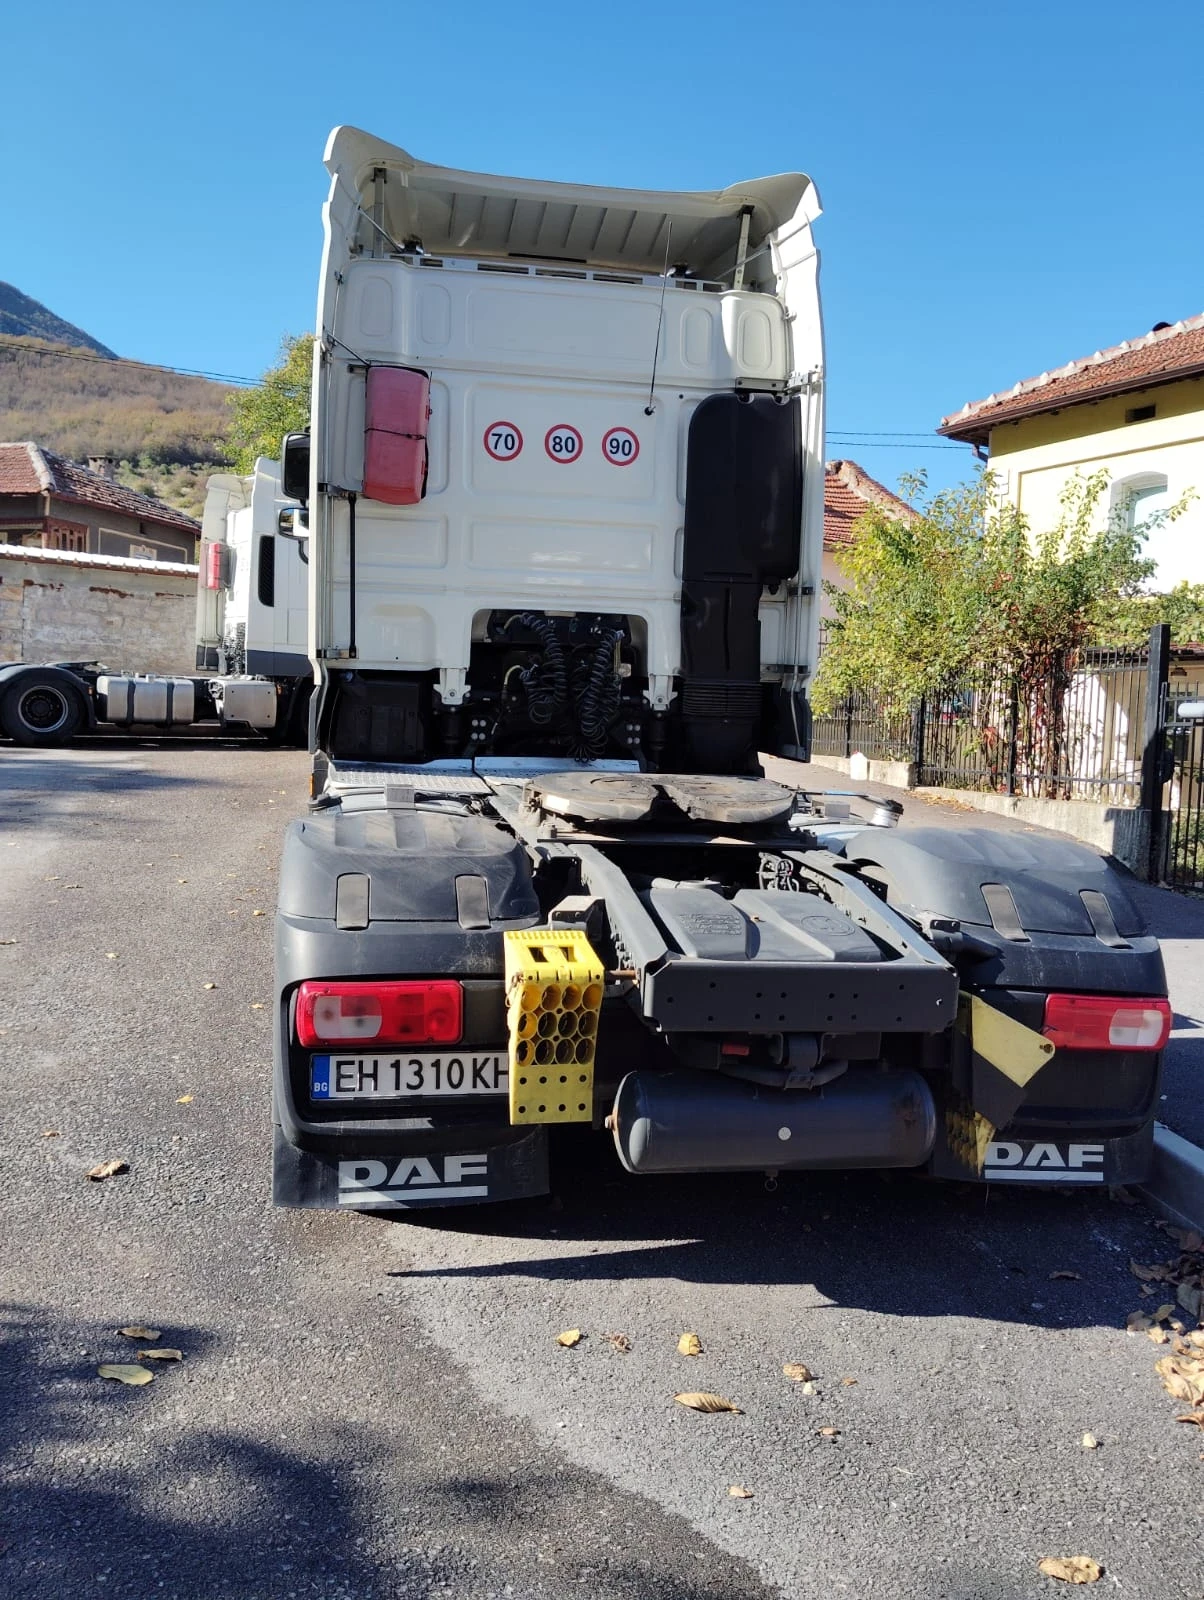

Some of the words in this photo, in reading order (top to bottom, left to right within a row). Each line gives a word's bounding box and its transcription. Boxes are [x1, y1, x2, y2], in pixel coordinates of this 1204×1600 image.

[491, 433, 515, 450] 70
[552, 436, 576, 453] 80
[609, 438, 632, 456] 90
[313, 1082, 328, 1092] BG
[984, 1141, 1104, 1168] DAF
[338, 1154, 488, 1188] DAF
